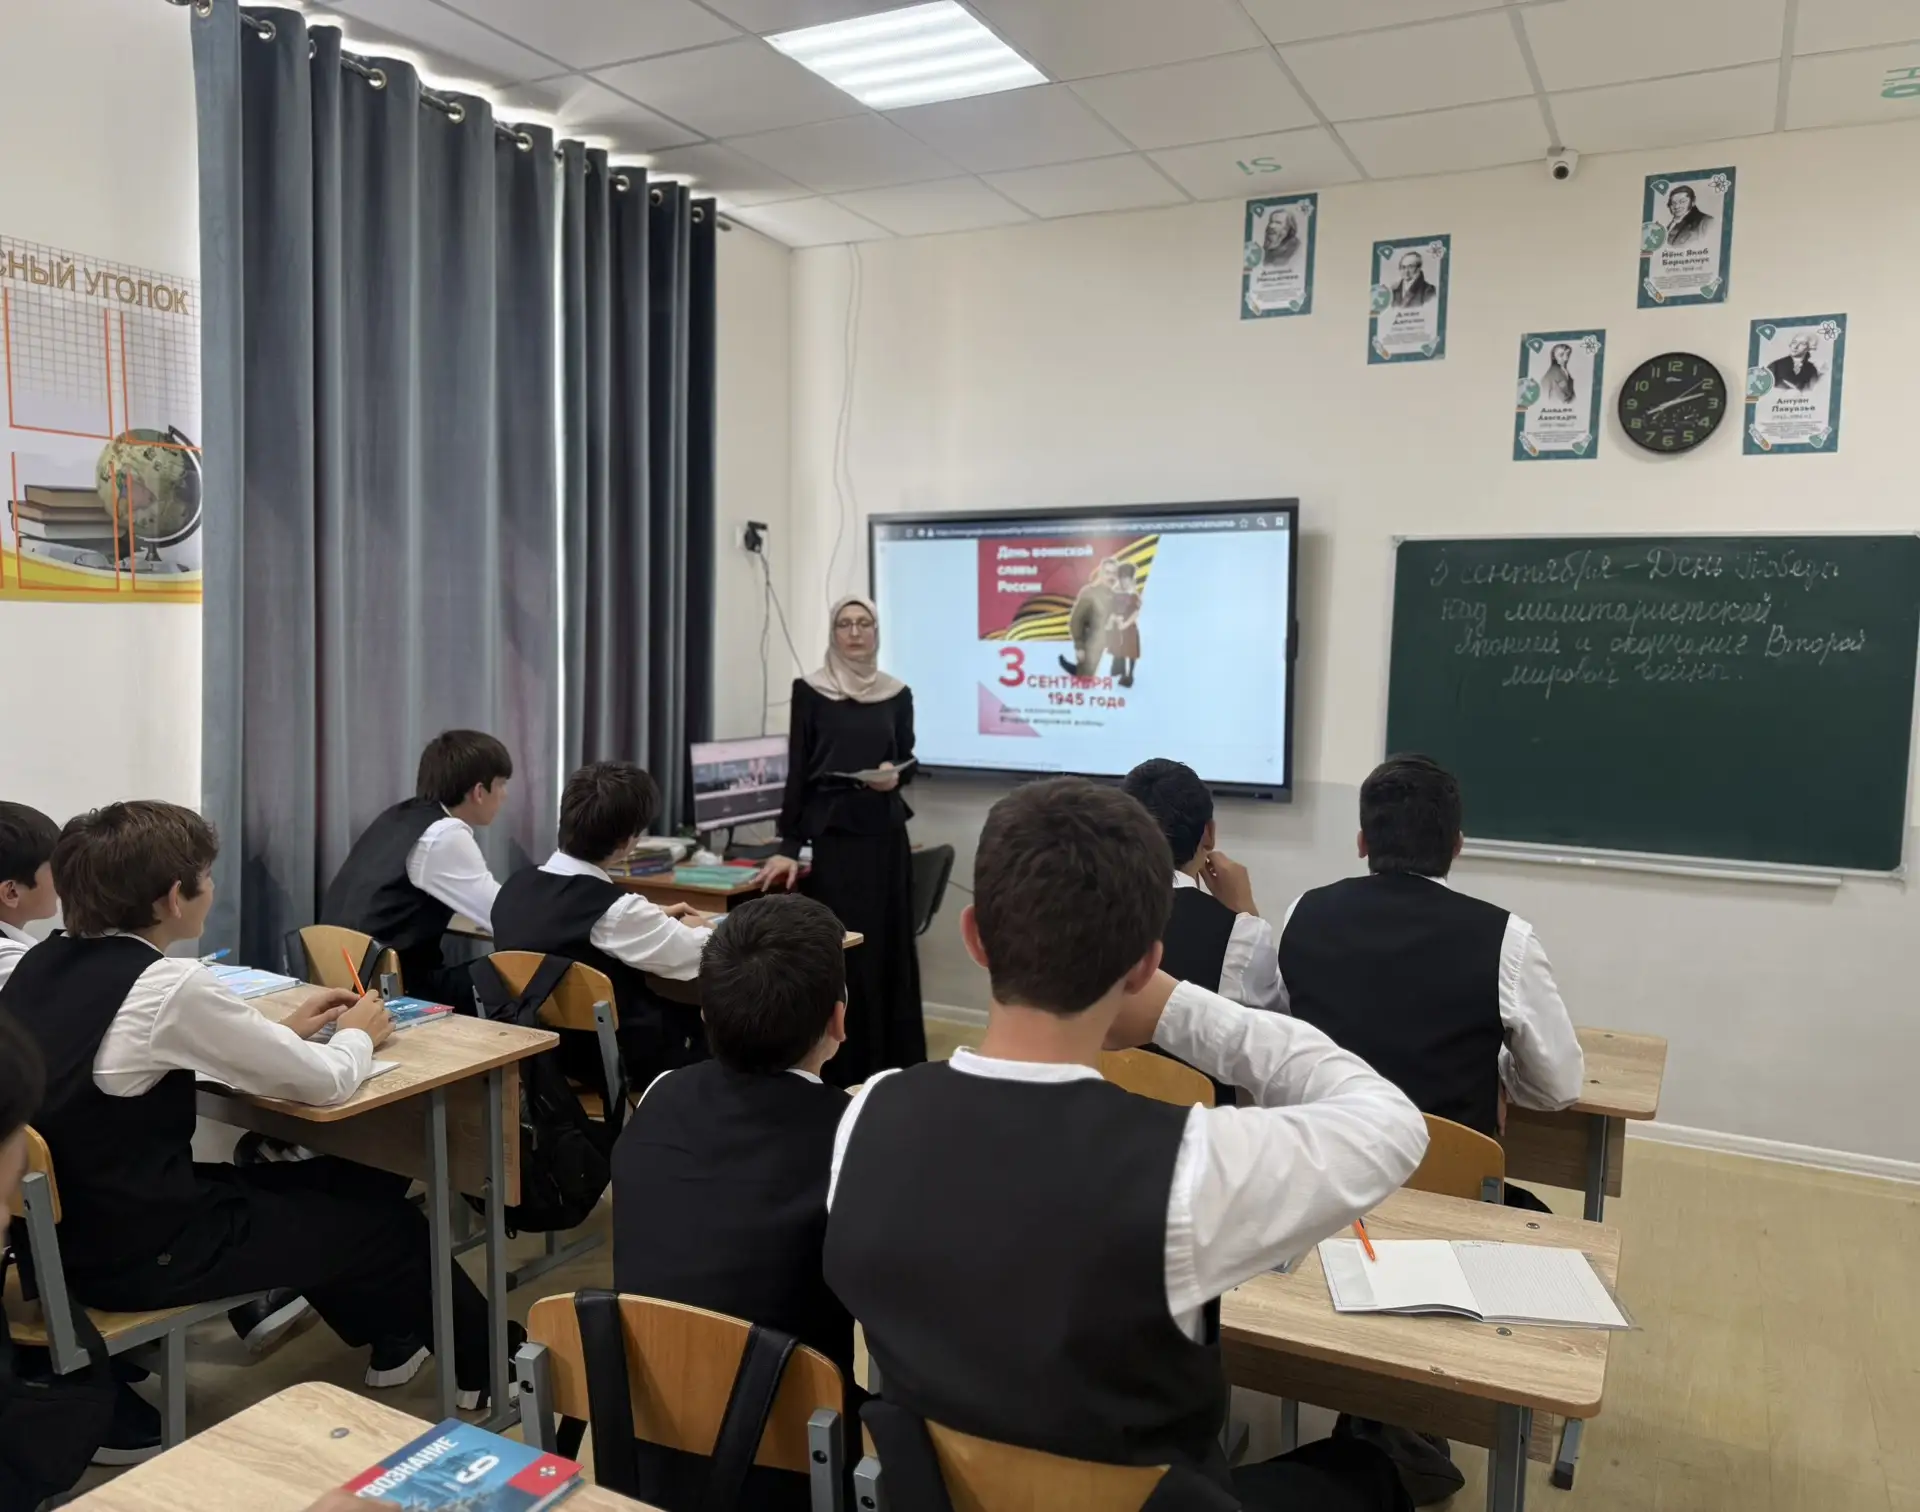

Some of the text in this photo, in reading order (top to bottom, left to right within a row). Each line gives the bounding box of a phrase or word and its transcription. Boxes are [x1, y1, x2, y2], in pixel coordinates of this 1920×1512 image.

[84, 267, 188, 315] УГОЛОК
[1651, 366, 1660, 378] 11
[1667, 361, 1684, 372] 12
[1692, 364, 1698, 376] 1
[1635, 380, 1649, 392] 10
[1702, 378, 1714, 390] 2
[1626, 398, 1638, 410] 9
[1707, 397, 1719, 409] 3
[1630, 418, 1641, 429] 8
[1698, 416, 1710, 428] 4
[1645, 431, 1656, 443] 7
[1662, 435, 1674, 447] 6
[1683, 430, 1694, 442] 5
[997, 545, 1030, 560] День
[1647, 546, 1723, 580] День
[998, 580, 1042, 593] России
[1575, 636, 1593, 651] и
[1764, 624, 1866, 665] Второй
[998, 646, 1113, 690] 3 СЕНТЯБРЯ
[1047, 692, 1084, 706] 1945
